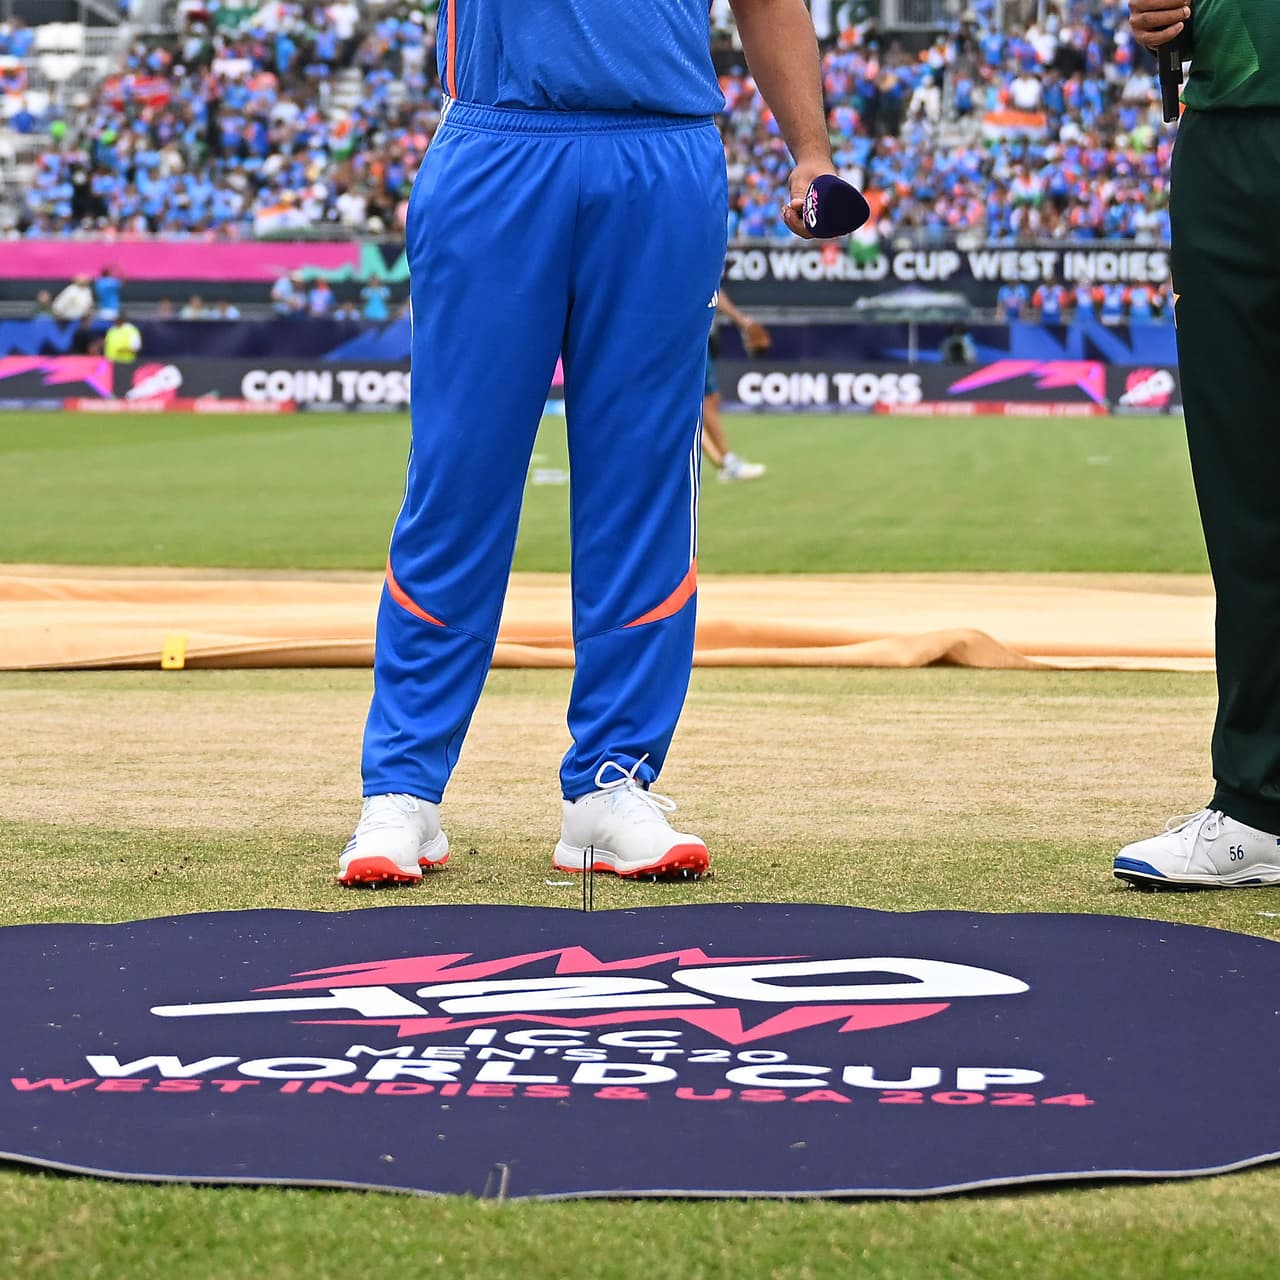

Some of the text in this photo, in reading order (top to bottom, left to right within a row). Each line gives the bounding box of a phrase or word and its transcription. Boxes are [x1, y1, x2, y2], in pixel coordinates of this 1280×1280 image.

[892, 251, 961, 281] CUP
[968, 251, 1058, 281] WEST
[1064, 251, 1170, 282] INDIES
[241, 370, 333, 403] COIN
[736, 372, 828, 405] COIN
[832, 372, 923, 405] TOSS
[1229, 844, 1245, 862] 56
[150, 957, 1031, 1017] T20
[465, 1028, 683, 1048] ICC
[345, 1045, 789, 1064] MEN'S T20
[85, 1055, 1046, 1091] WORLD CUP
[10, 1078, 1095, 1107] WEST INDIES & USA 2024
